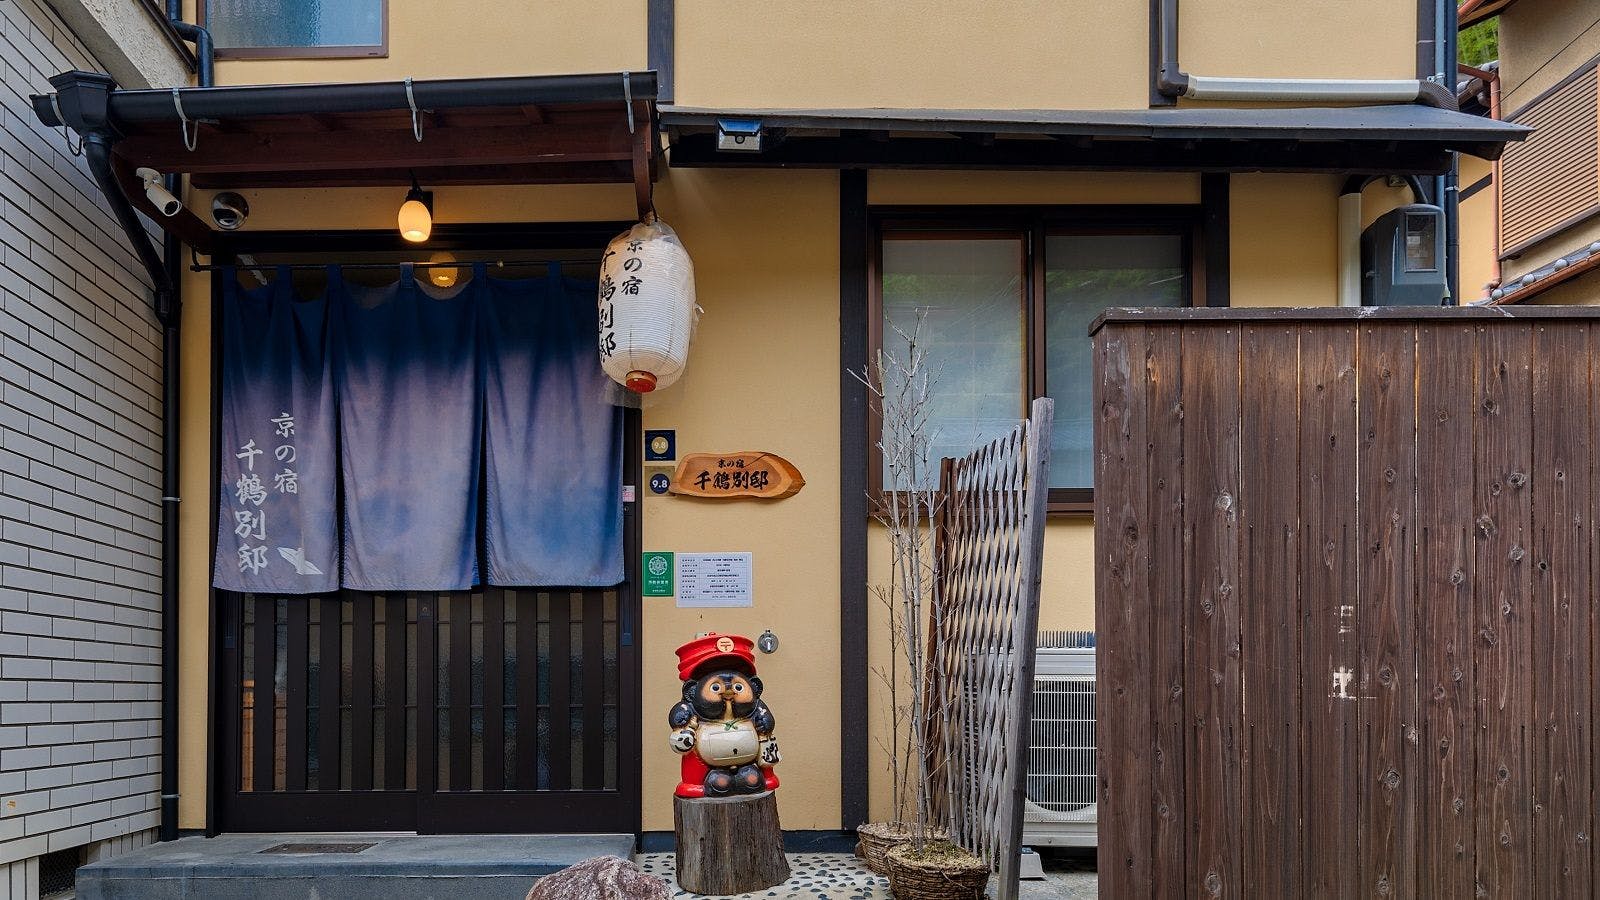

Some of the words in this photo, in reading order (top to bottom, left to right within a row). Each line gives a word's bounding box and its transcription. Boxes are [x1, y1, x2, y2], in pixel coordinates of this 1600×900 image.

[654, 441, 666, 449] 9.8
[270, 412, 298, 495] 京の宿
[716, 458, 745, 468] 京の宿
[652, 479, 668, 488] 9.8
[693, 470, 769, 491] 千鶴別邸
[234, 438, 268, 576] 千鶴別邸
